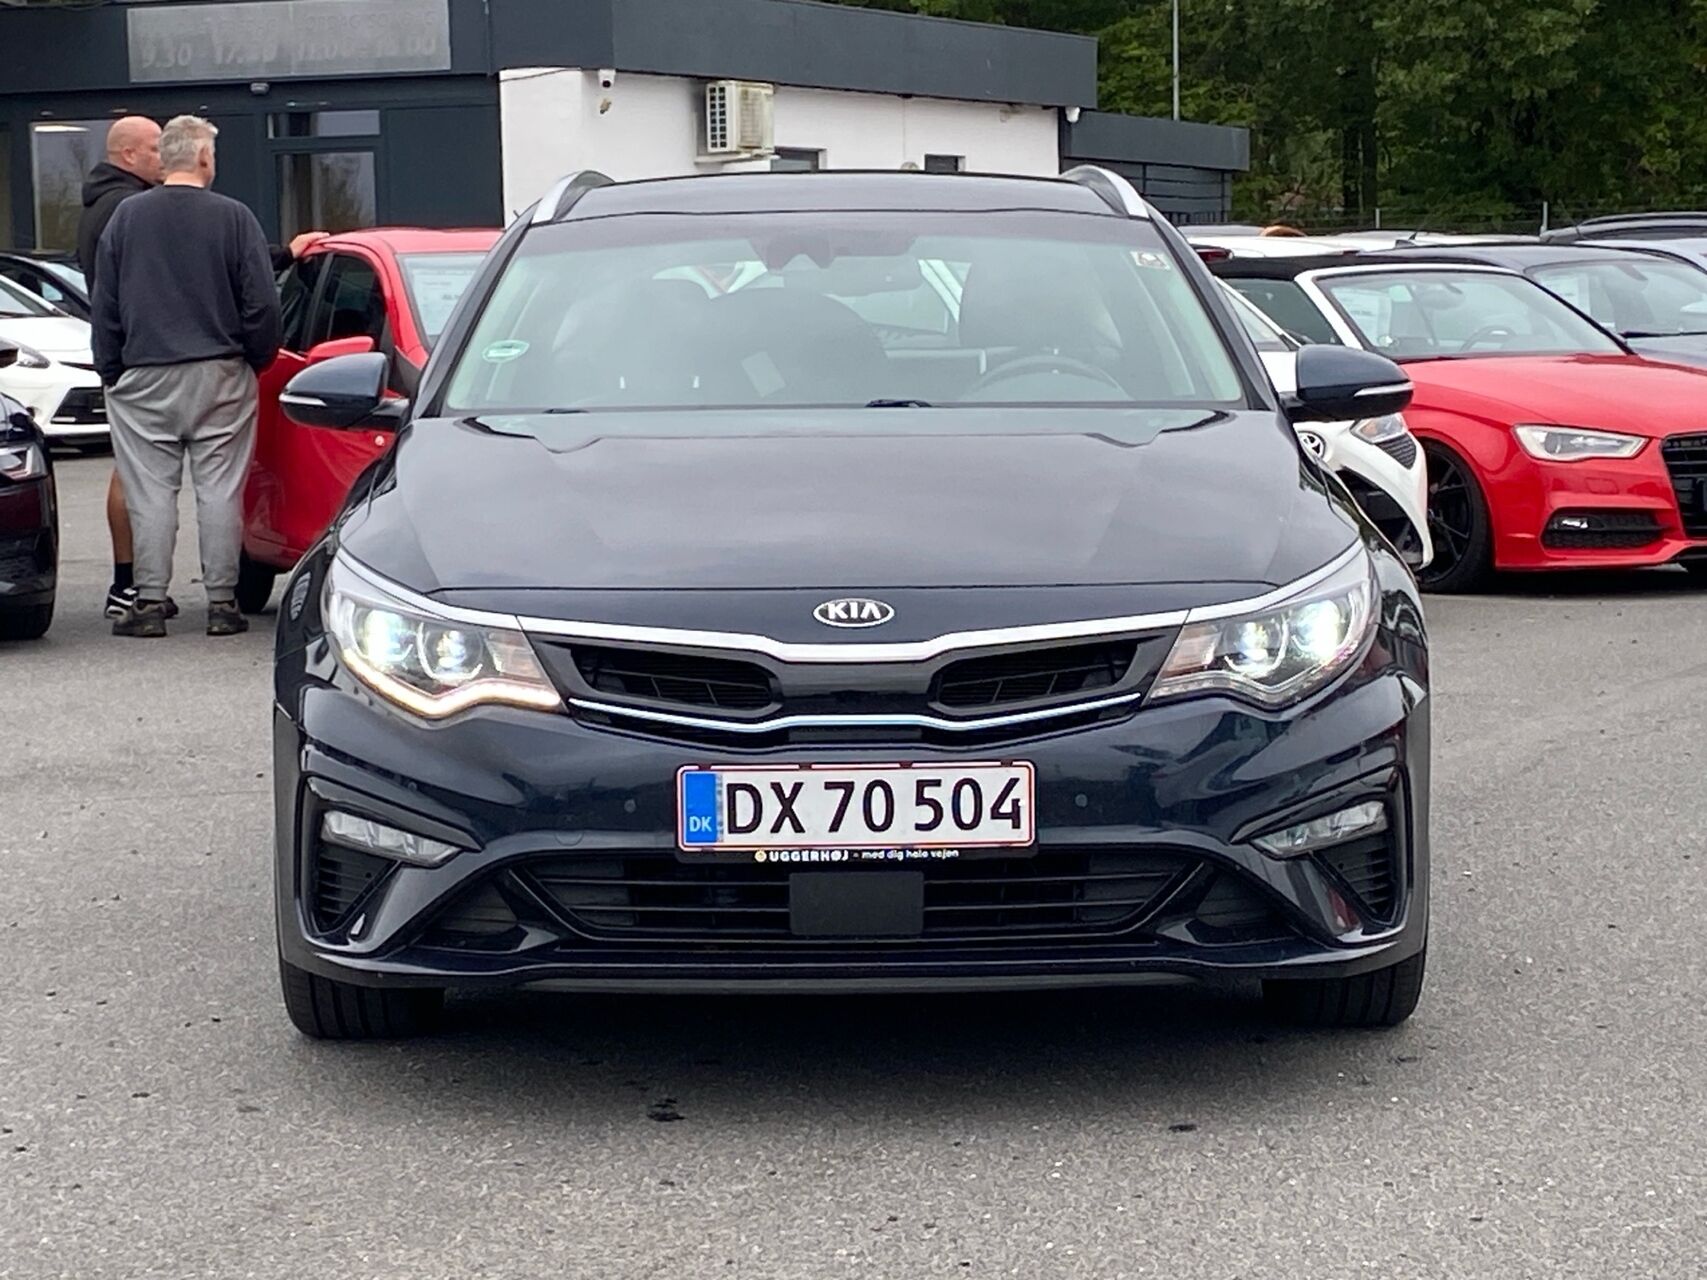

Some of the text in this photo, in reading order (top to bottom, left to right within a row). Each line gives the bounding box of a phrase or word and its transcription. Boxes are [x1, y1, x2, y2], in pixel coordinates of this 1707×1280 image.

[828, 602, 881, 619] KIA
[726, 777, 1022, 834] DX 70 504
[689, 815, 712, 832] DK
[769, 850, 849, 862] UGGERHØJ
[861, 850, 885, 859] med
[886, 849, 904, 861] dig
